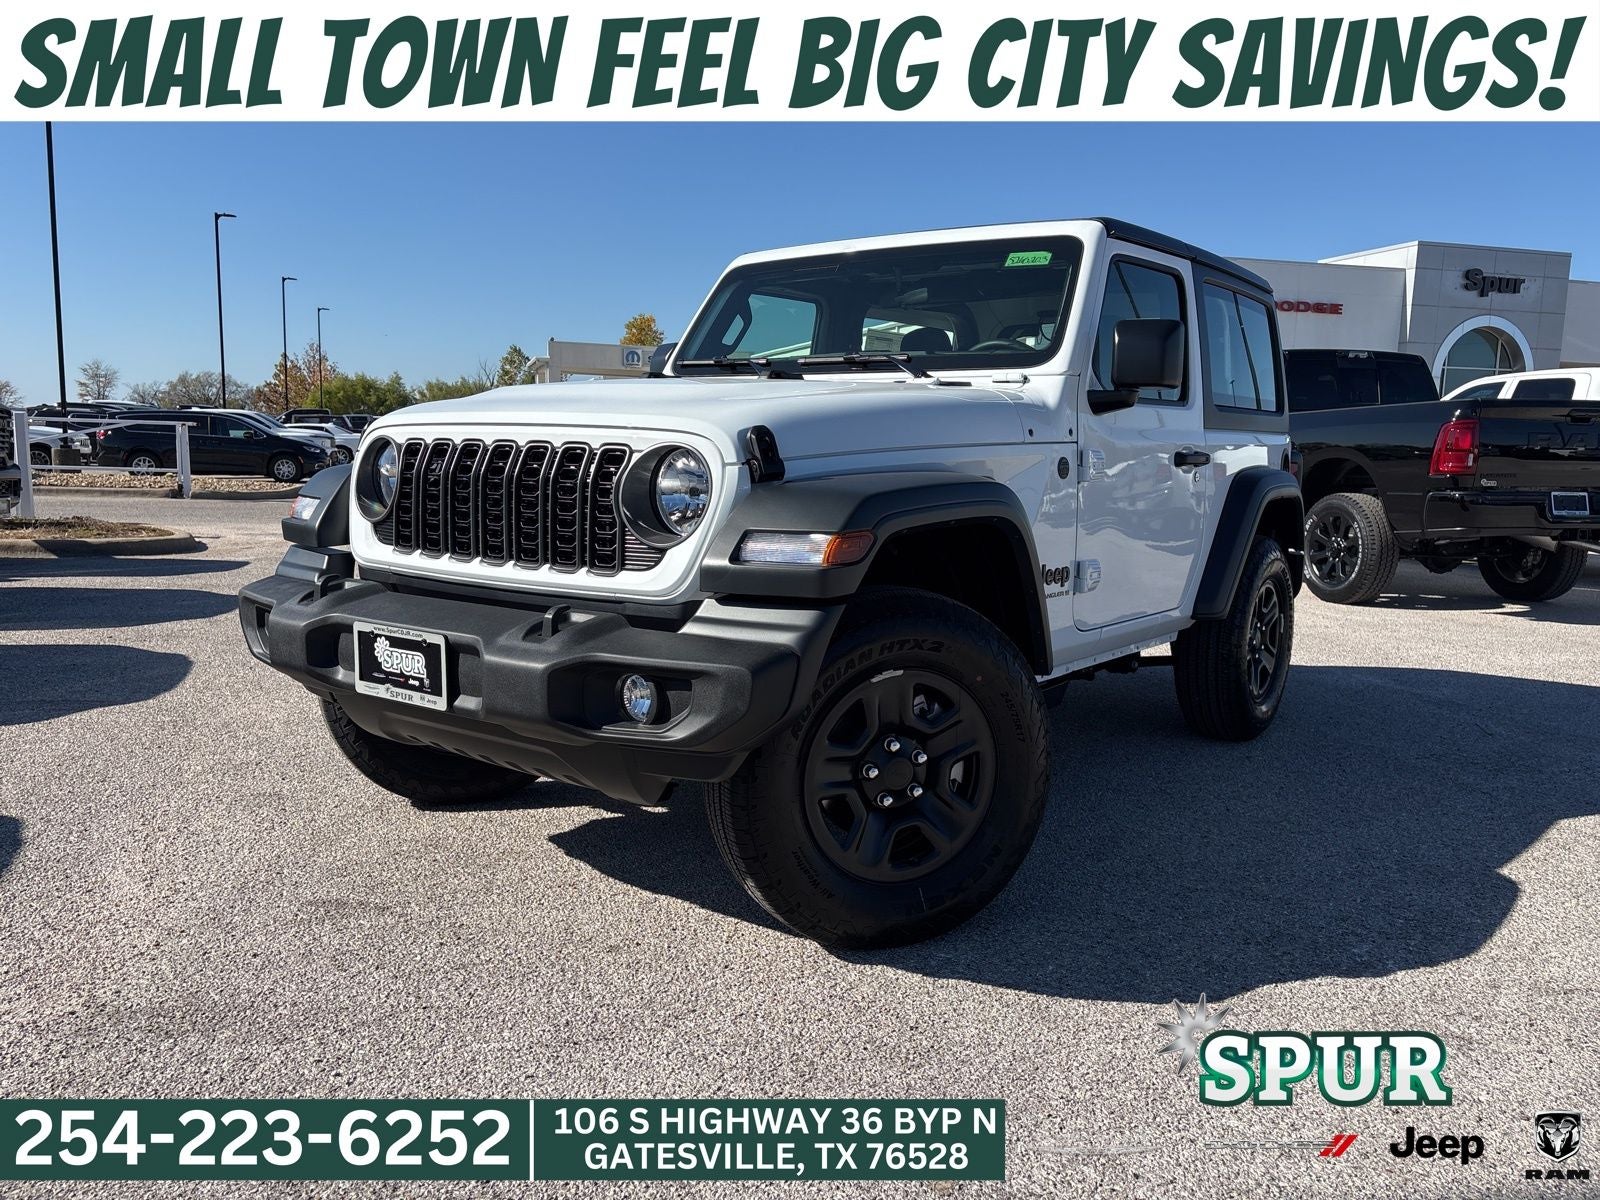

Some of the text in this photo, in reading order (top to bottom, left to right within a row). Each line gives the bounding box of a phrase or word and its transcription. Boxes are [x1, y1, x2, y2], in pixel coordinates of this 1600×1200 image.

[1463, 268, 1526, 297] Spur
[1275, 300, 1344, 315] ODGE
[878, 639, 945, 657] HTX2
[383, 648, 425, 676] SPUR
[408, 678, 419, 686] Jeep
[390, 690, 413, 702] SPUR
